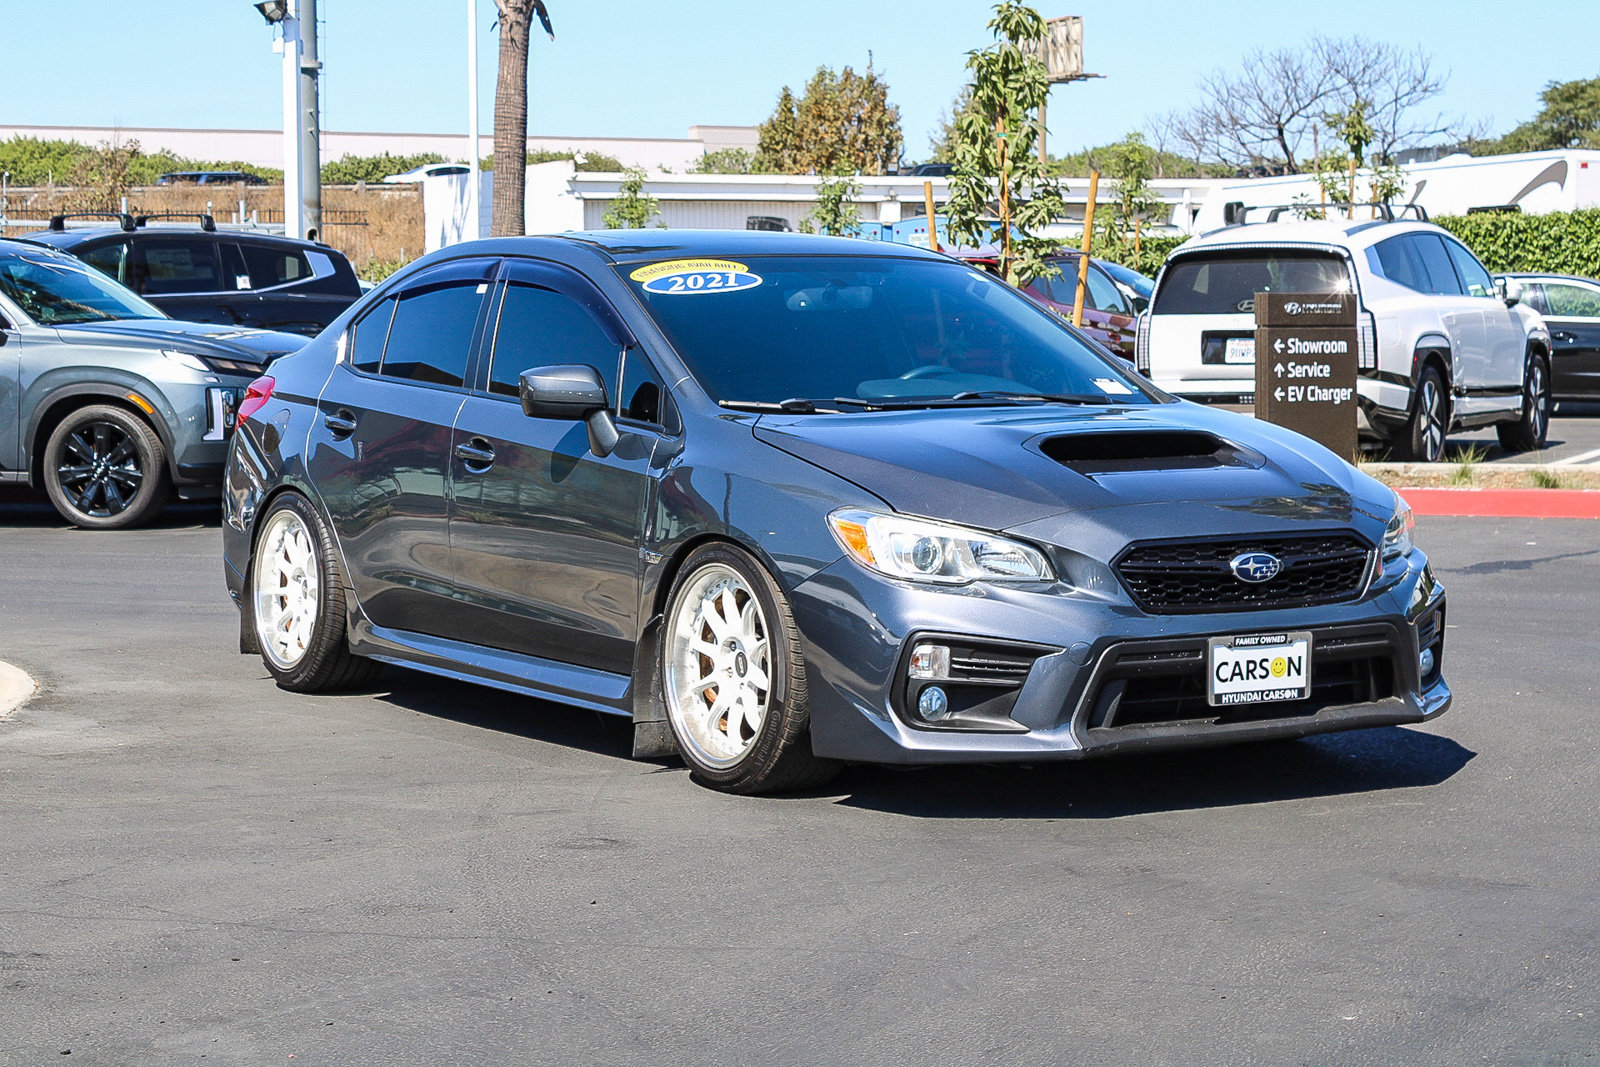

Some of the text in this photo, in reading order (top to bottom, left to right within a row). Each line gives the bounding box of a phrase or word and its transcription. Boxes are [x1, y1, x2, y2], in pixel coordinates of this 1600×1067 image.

[668, 273, 739, 292] 2021
[1287, 338, 1348, 354] Showroom
[1287, 361, 1331, 378] Service
[1287, 385, 1353, 404] EV Charger
[1235, 635, 1286, 646] FAMILY OWNED
[1222, 689, 1298, 704] HYUNDAI CARSON
